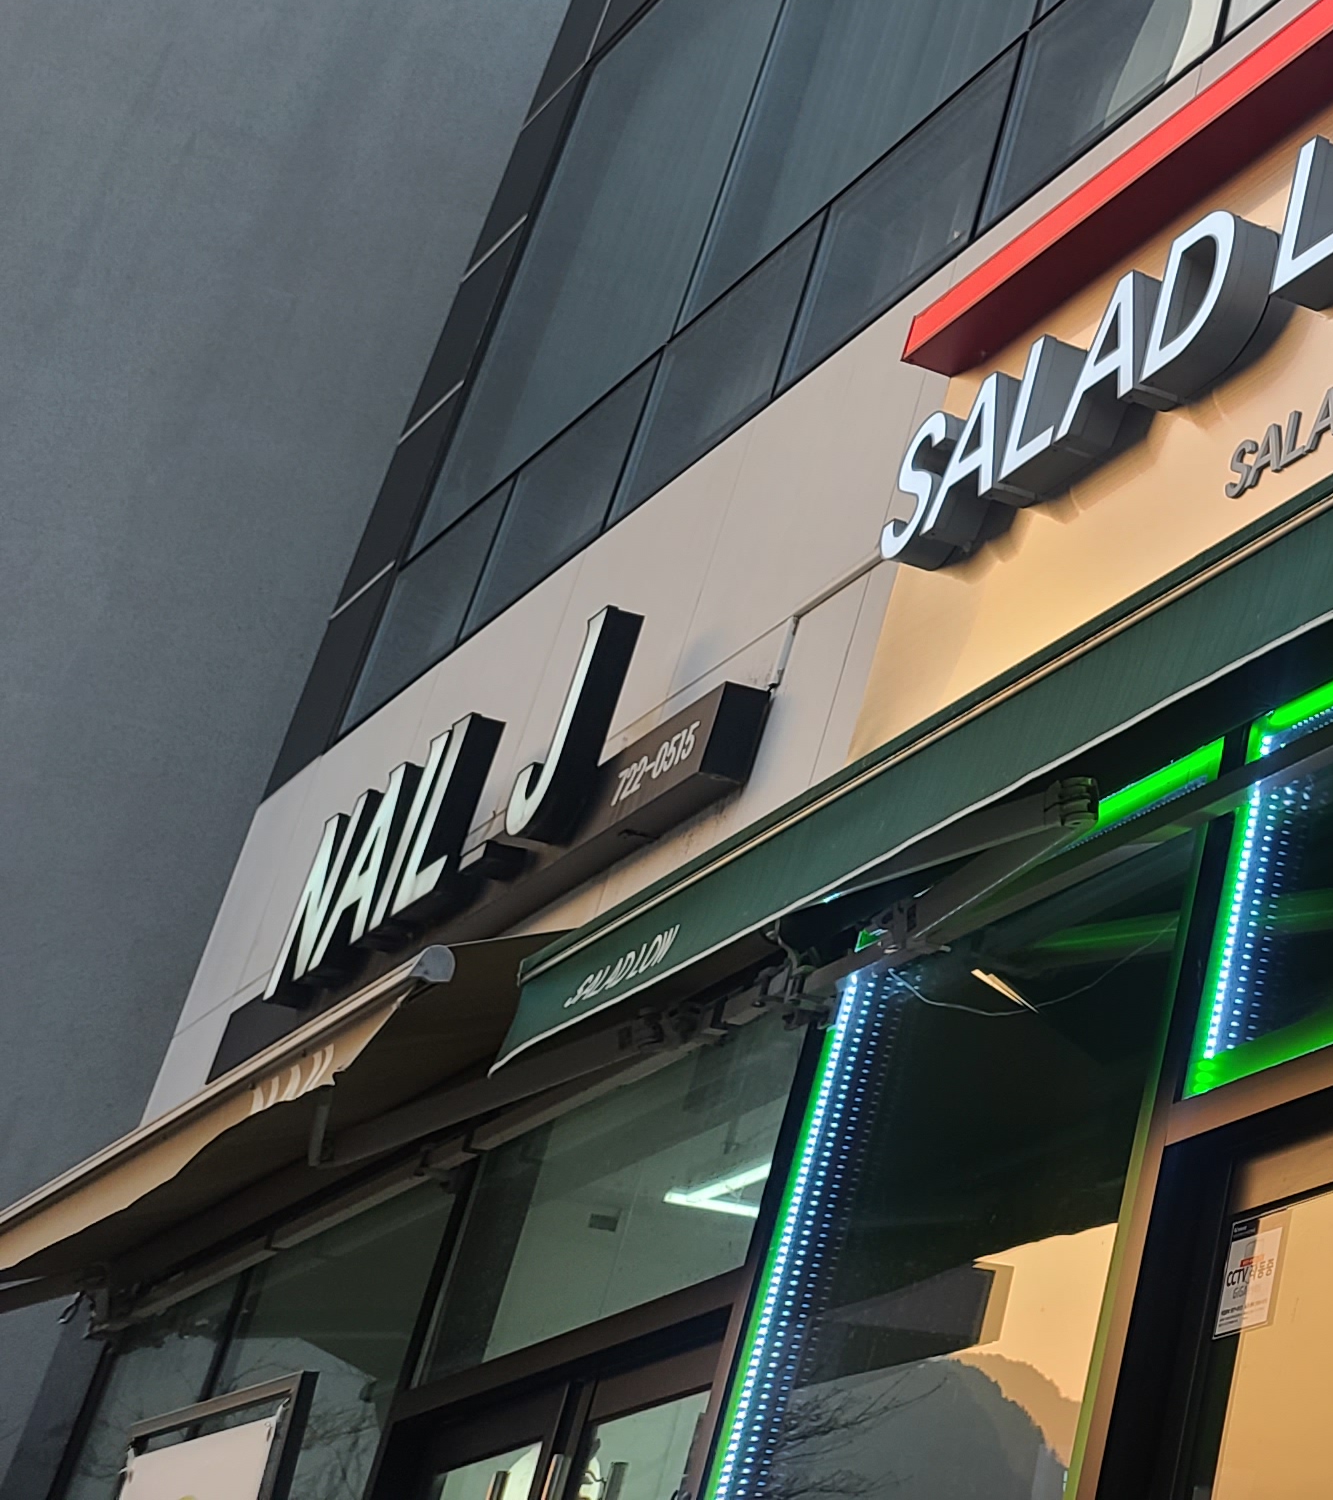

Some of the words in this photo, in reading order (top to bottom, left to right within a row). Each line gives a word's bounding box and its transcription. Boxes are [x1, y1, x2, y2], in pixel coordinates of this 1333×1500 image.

[880, 210, 1238, 562] SALAD
[505, 604, 615, 837] J
[610, 720, 701, 807] 722-0515
[625, 923, 681, 981] LOW
[1226, 1266, 1250, 1288] CCTV
